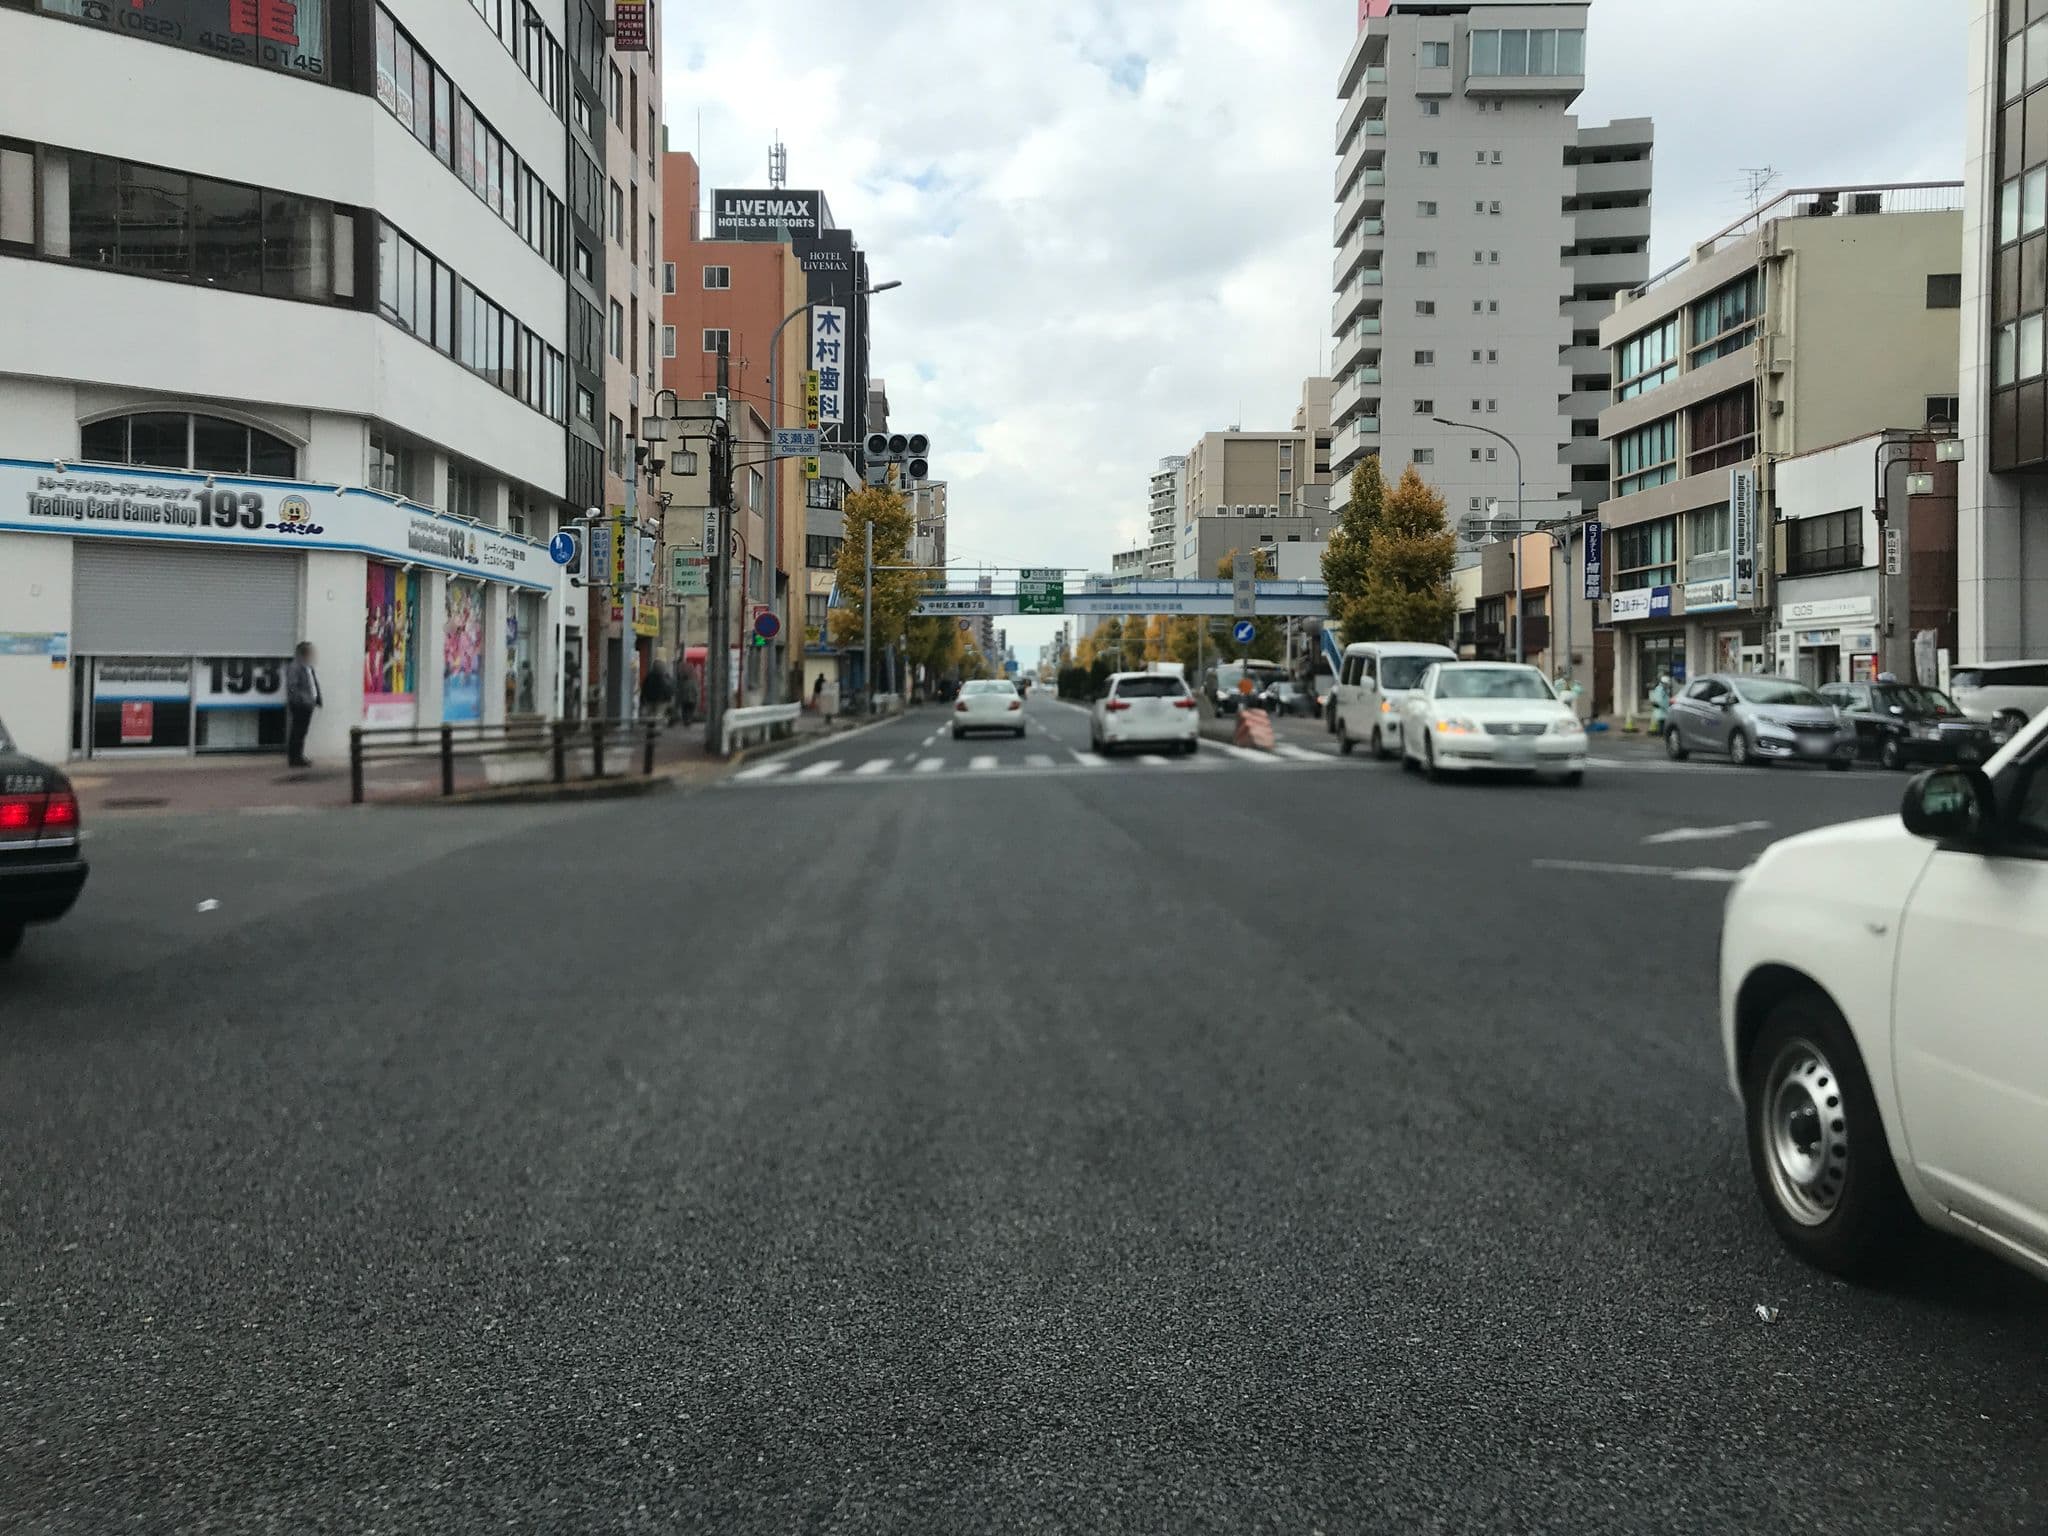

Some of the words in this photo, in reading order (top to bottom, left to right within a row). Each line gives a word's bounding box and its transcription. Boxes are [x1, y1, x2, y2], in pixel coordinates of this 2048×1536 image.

[718, 218, 757, 227] HOTELS
[758, 218, 767, 227] &
[768, 218, 816, 228] RESORTS
[810, 252, 842, 261] HOTEL
[816, 310, 841, 419] 木村歯科
[27, 491, 83, 520] Trading
[86, 496, 120, 521] Card
[122, 500, 161, 523] Game
[163, 501, 197, 528] Shop
[192, 488, 264, 530] 193
[1737, 558, 1752, 579] 193
[210, 657, 280, 694] 193
